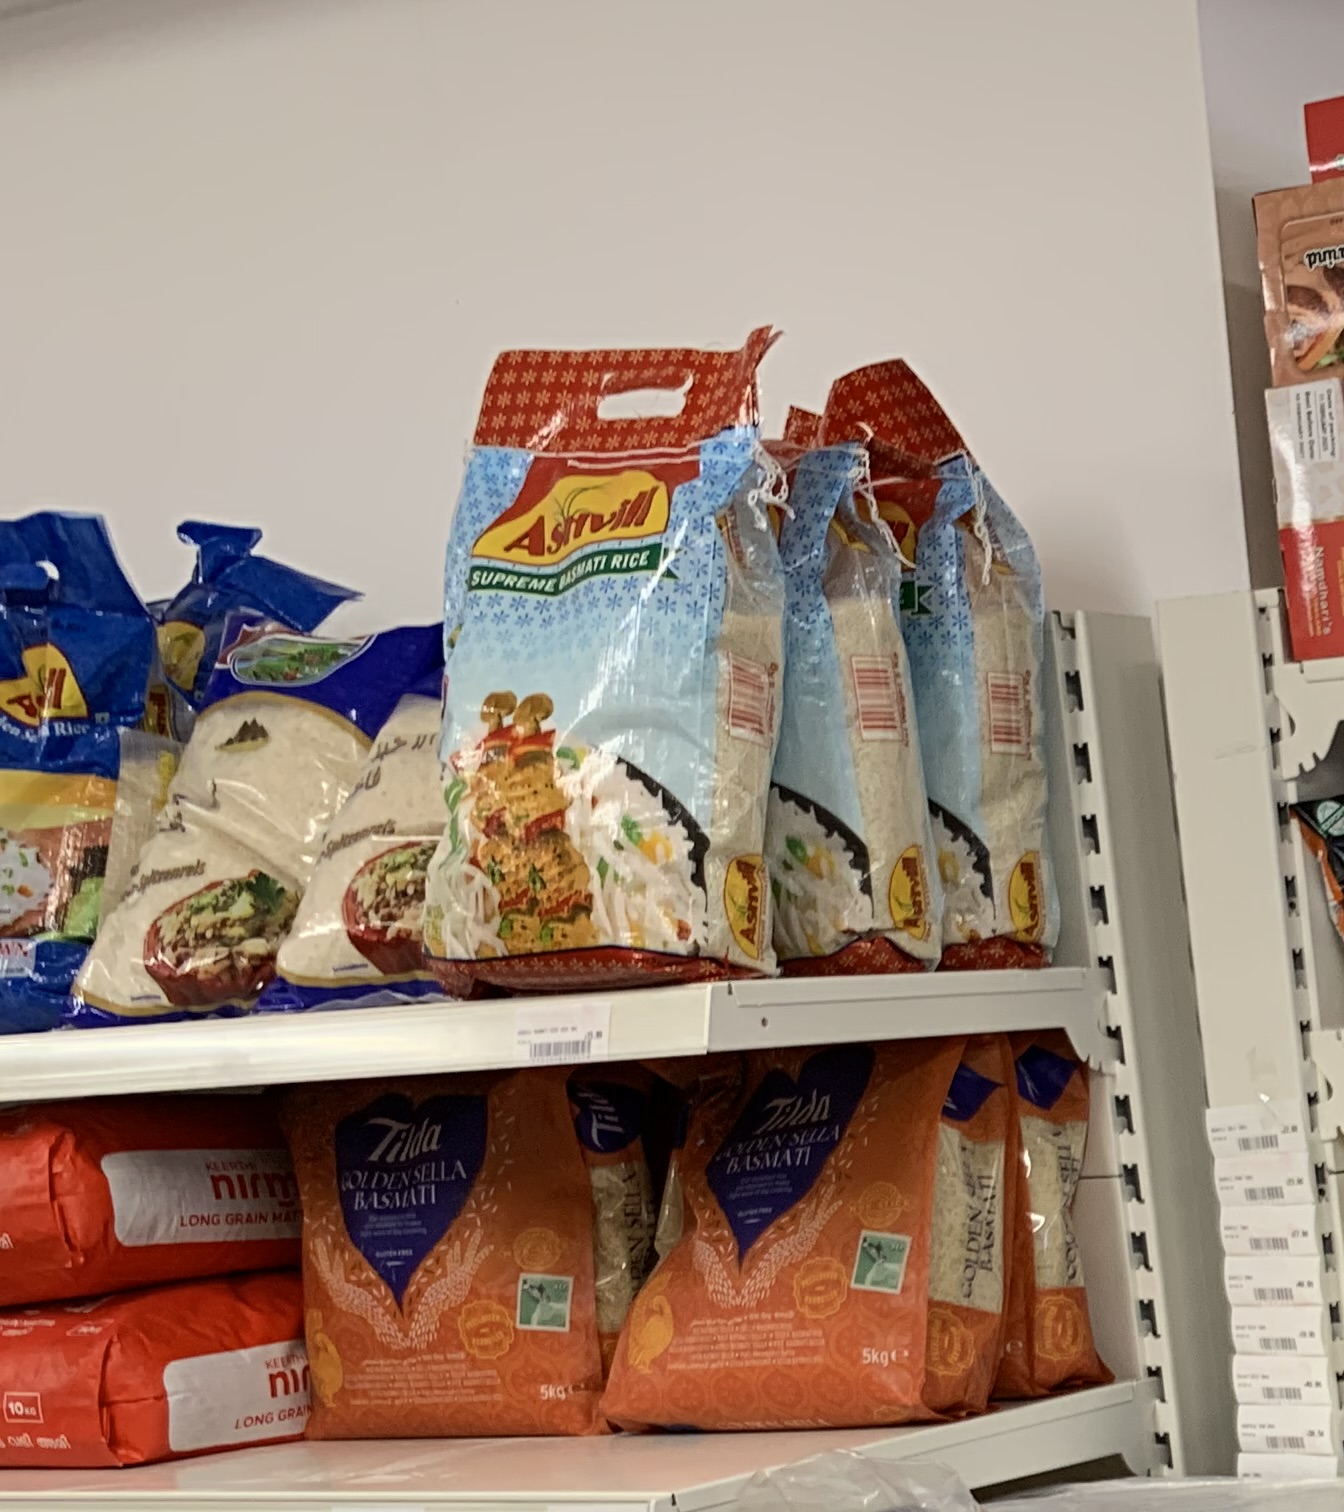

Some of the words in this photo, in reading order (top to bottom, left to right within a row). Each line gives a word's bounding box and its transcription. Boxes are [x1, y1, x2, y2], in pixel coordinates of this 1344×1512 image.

[470, 570, 558, 593] SUPREME
[559, 557, 607, 590] BASMATI
[610, 550, 649, 570] RICE
[1315, 546, 1332, 635] Namdhari's
[752, 1089, 832, 1135] Tilda
[364, 1117, 442, 1163] Tilda
[412, 1159, 467, 1183] SELLA
[724, 1144, 812, 1175] BASMATI
[211, 1170, 298, 1202] nirm
[354, 1184, 436, 1211] BASMATI
[179, 1214, 224, 1228] LONG
[226, 1213, 268, 1227] GRAIN
[862, 1348, 890, 1367] 5kg
[234, 1414, 272, 1430] LONG
